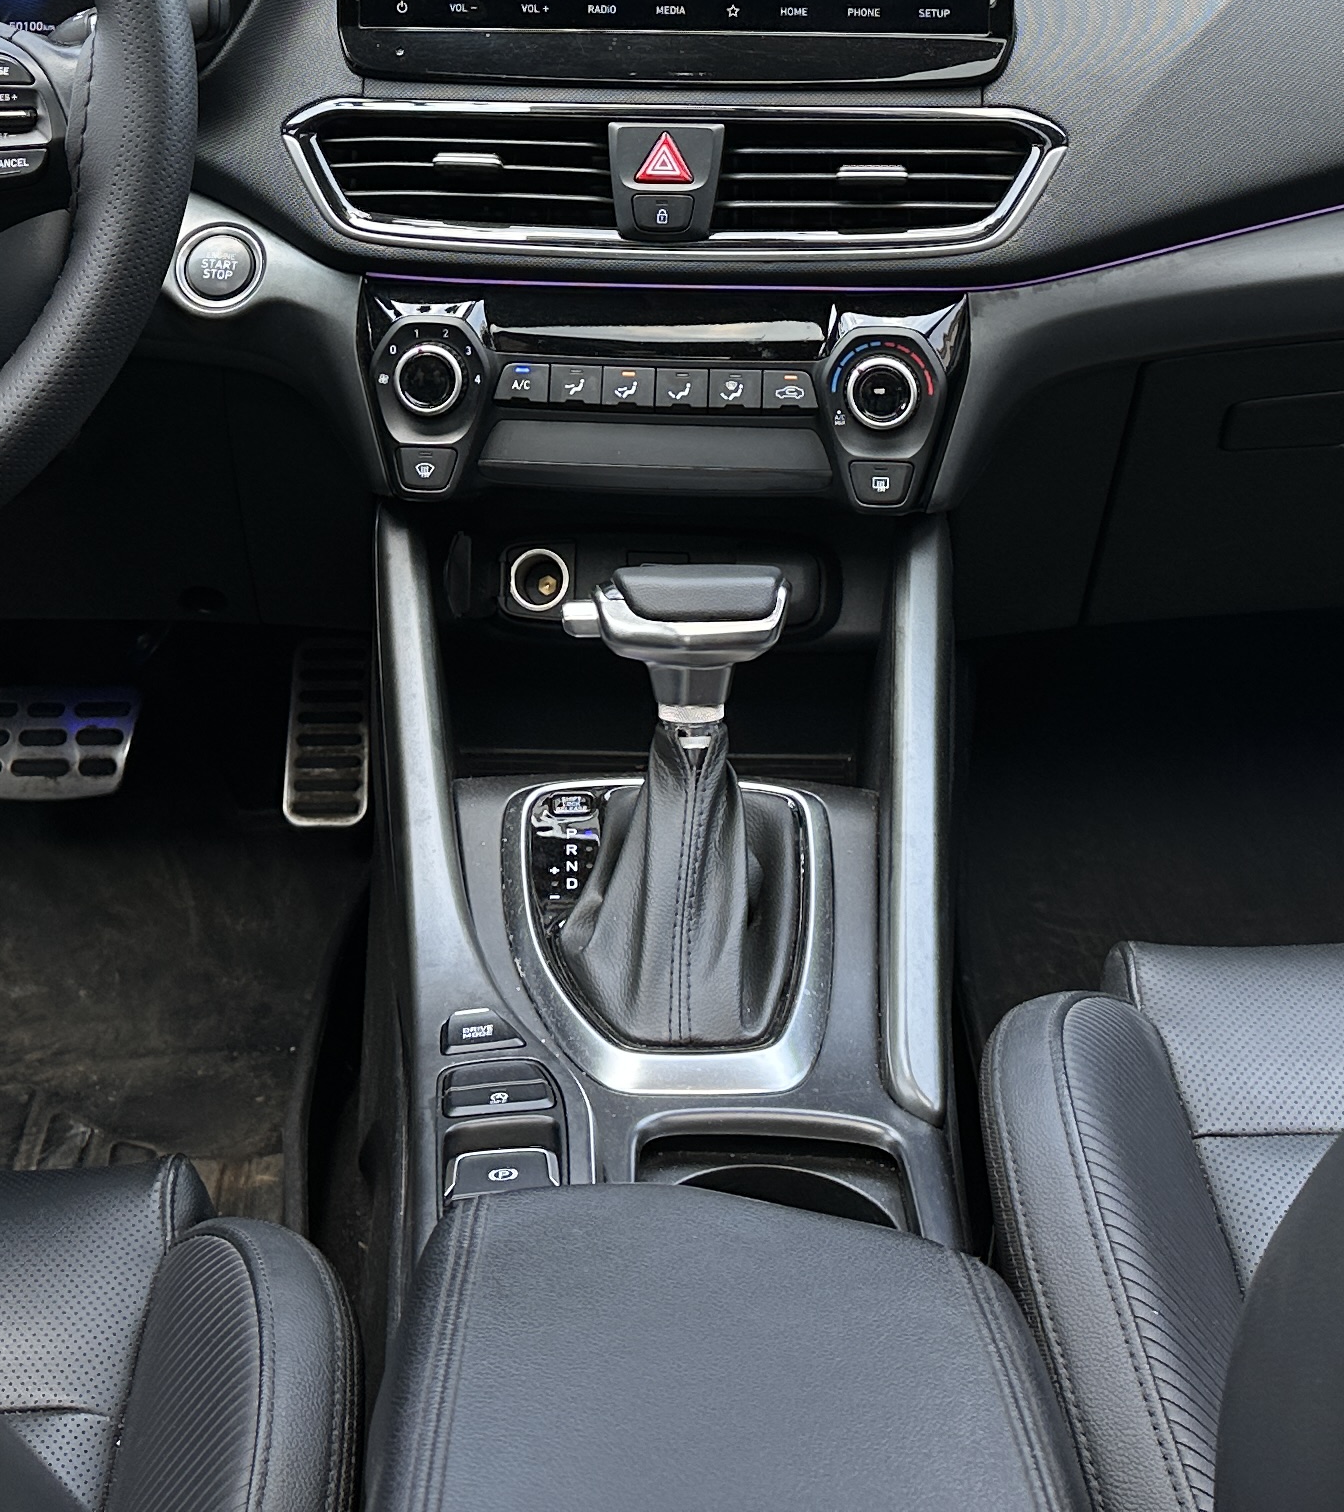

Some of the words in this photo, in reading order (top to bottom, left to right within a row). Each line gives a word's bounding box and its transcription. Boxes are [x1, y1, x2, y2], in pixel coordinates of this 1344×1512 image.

[656, 5, 686, 16] MEDIA
[780, 7, 808, 17] HOME
[847, 7, 881, 18] PHONE
[918, 8, 951, 19] SETUP
[201, 259, 238, 270] START
[203, 268, 234, 280] STOP
[413, 328, 419, 339] 1
[442, 328, 449, 338] 2
[389, 344, 397, 355] 0
[465, 345, 472, 356] 3
[474, 374, 481, 384] 4
[511, 379, 531, 390] A/C
[566, 828, 577, 839] P
[566, 844, 578, 856] R
[566, 860, 578, 872] N
[566, 877, 578, 890] D
